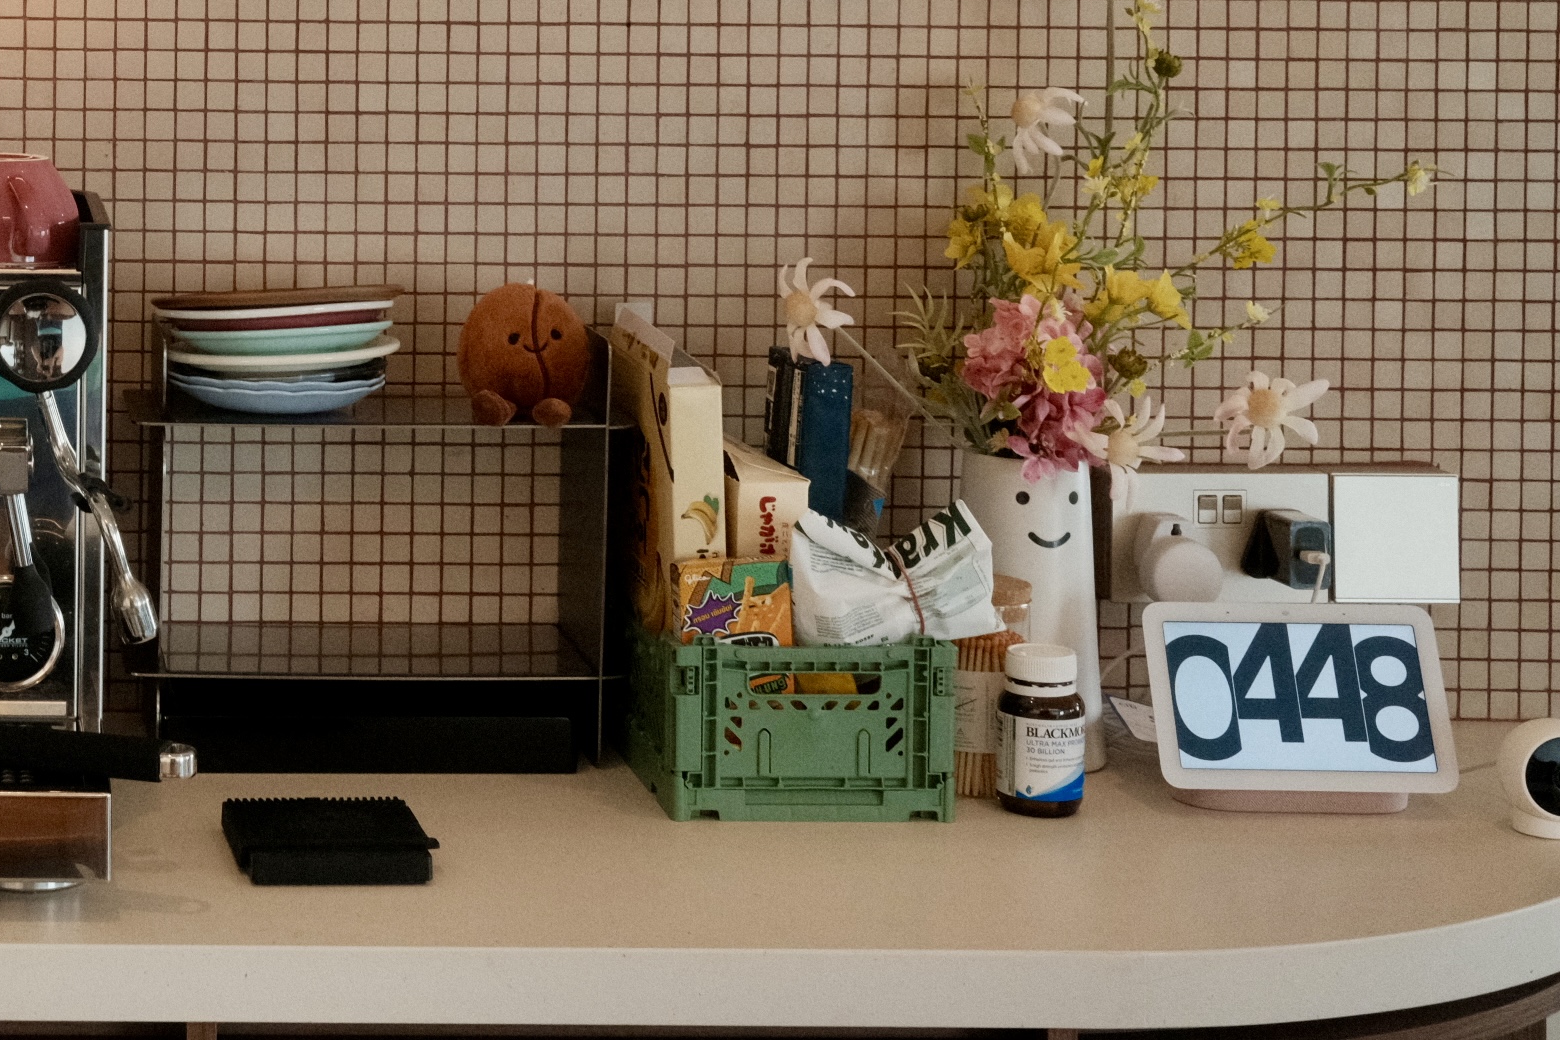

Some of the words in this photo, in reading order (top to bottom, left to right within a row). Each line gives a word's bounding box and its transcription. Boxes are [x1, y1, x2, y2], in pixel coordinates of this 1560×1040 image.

[24, 648, 29, 656] 3
[1165, 623, 1436, 763] 0448
[1037, 747, 1065, 755] BILLION
